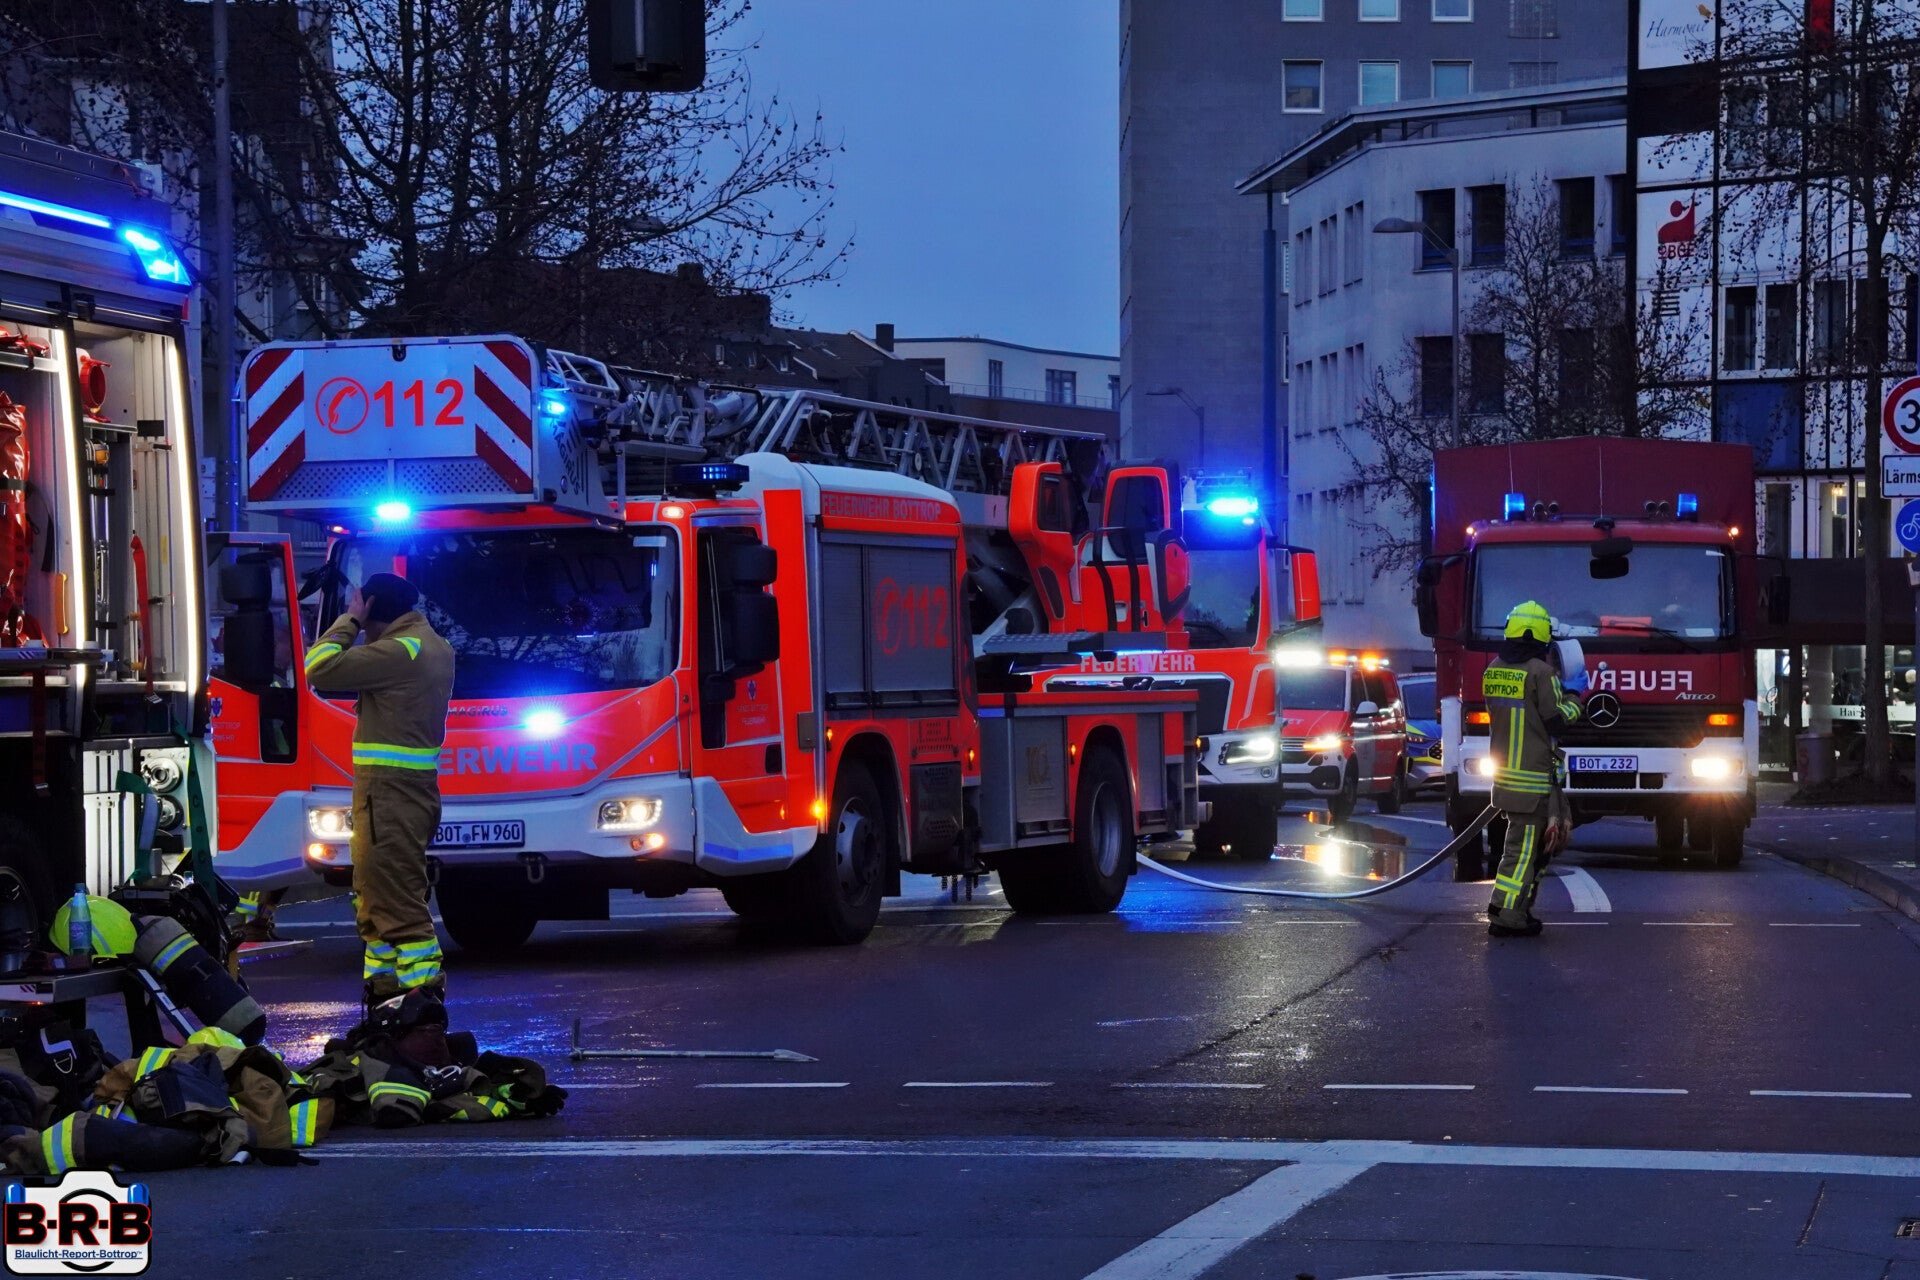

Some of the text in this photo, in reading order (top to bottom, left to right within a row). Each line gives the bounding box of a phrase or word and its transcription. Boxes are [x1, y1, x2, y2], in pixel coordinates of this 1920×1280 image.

[373, 378, 464, 427] 112
[822, 493, 941, 520] FEUERWEHR BOTTROP
[904, 584, 949, 648] 112
[1081, 653, 1196, 673] FEUERWEHR
[1484, 670, 1524, 682] FEUERWEHR
[1485, 684, 1519, 696] BOTTROP
[1580, 758, 1633, 769] BOT 232
[436, 823, 521, 842] BOT FW 960
